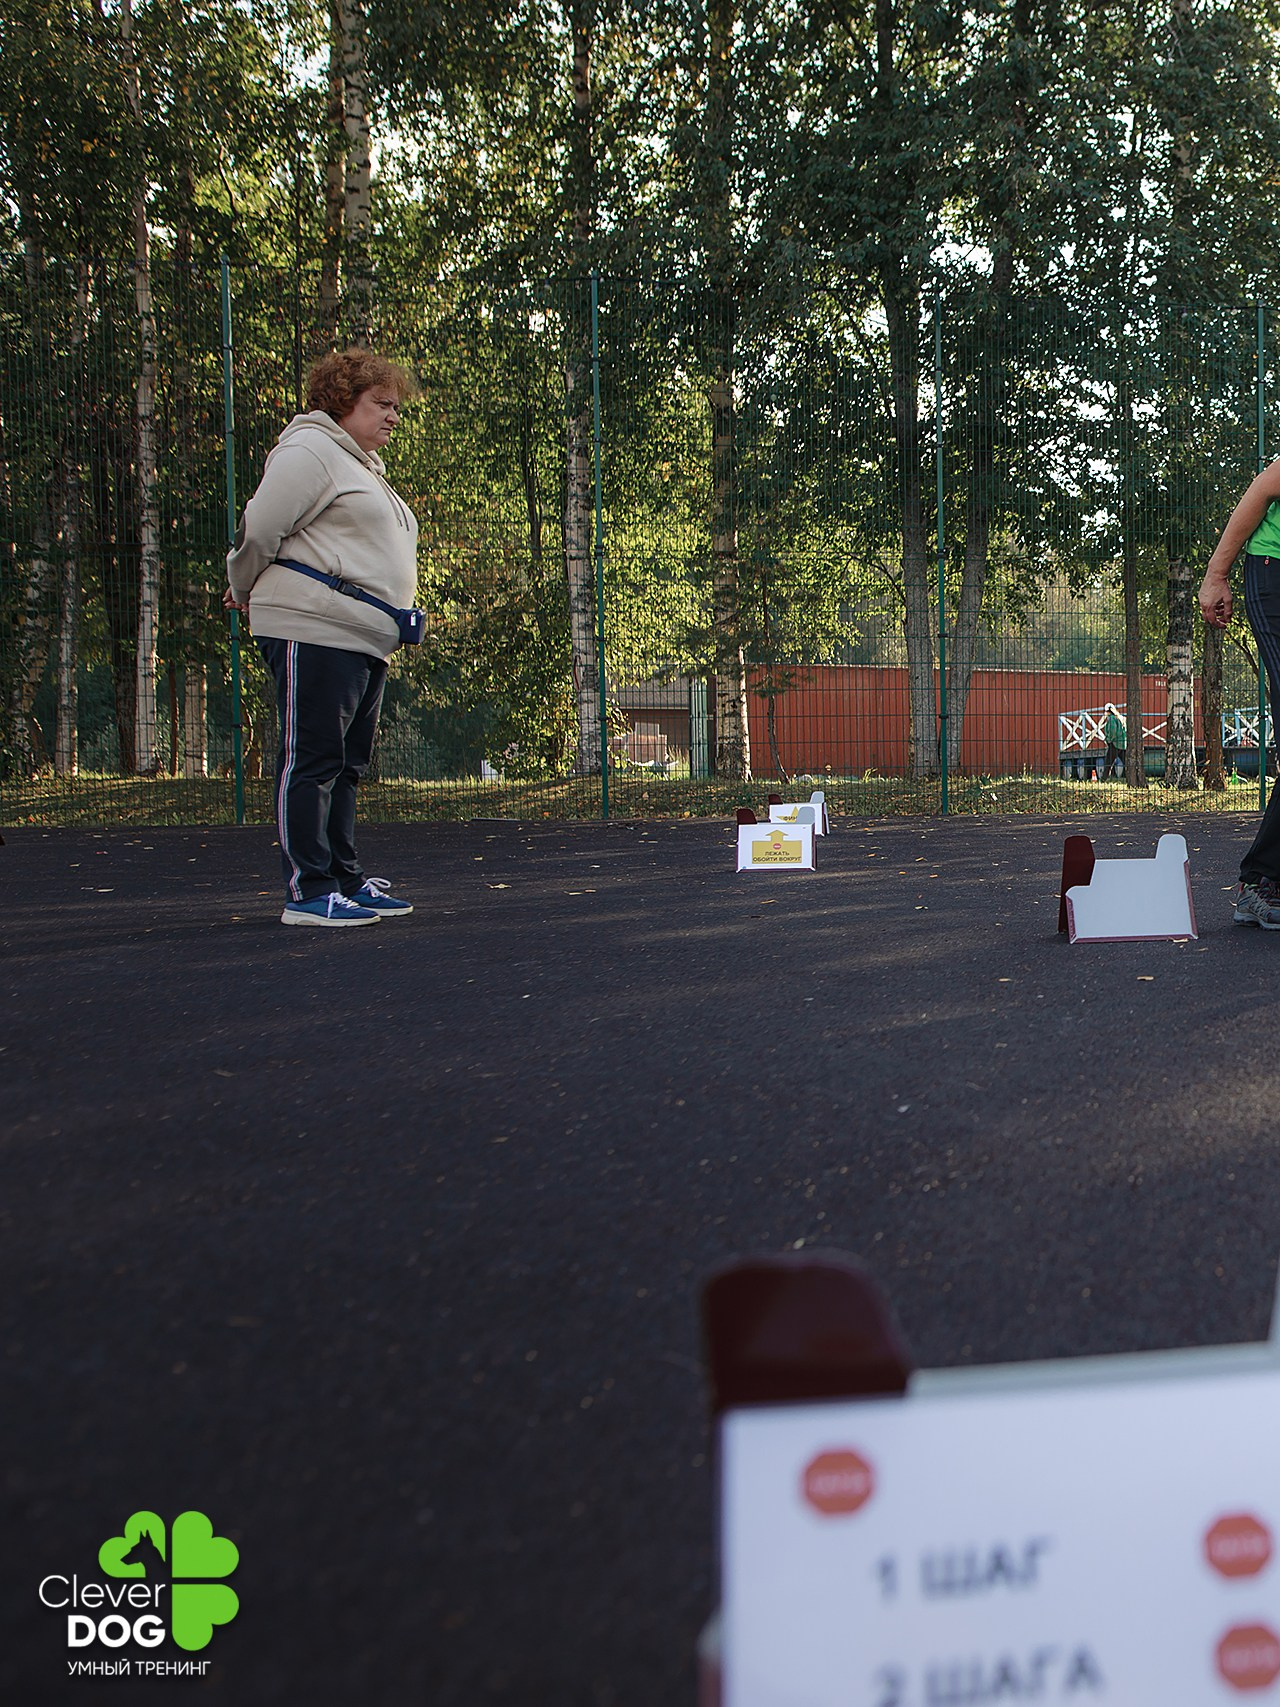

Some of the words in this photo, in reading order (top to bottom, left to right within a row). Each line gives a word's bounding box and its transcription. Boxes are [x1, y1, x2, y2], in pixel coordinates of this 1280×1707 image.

[875, 1554, 899, 1603] 1
[921, 1537, 1053, 1600] ШАГ
[925, 1644, 1105, 1707] ШАГА
